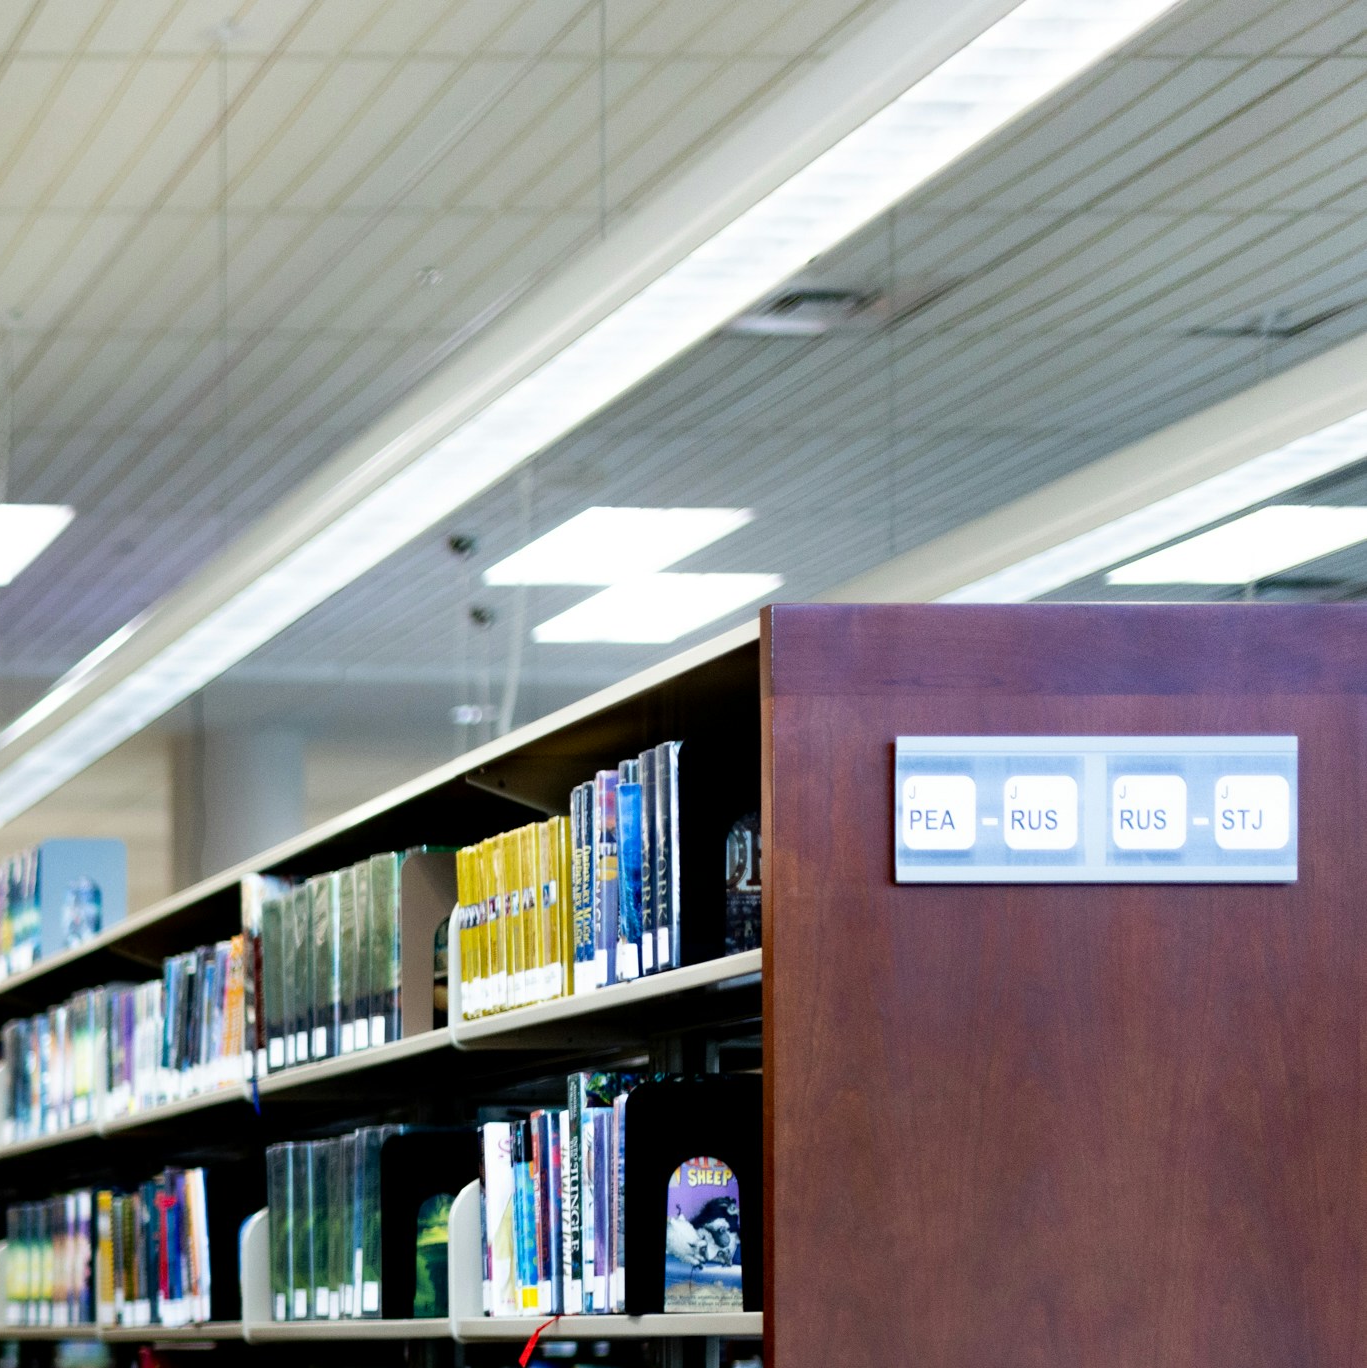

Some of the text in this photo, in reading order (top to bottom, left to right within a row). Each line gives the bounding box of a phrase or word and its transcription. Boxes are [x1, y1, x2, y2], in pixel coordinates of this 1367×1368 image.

[909, 786, 915, 800] J
[1010, 786, 1017, 800] J
[1119, 785, 1126, 799] J
[1221, 785, 1228, 799] J
[910, 810, 955, 830] PEA
[1012, 810, 1057, 830] RUS
[1121, 810, 1166, 830] RUS
[1222, 809, 1262, 830] STJ
[688, 1168, 733, 1186] SHEEP
[570, 1159, 580, 1251] JUNGLE
